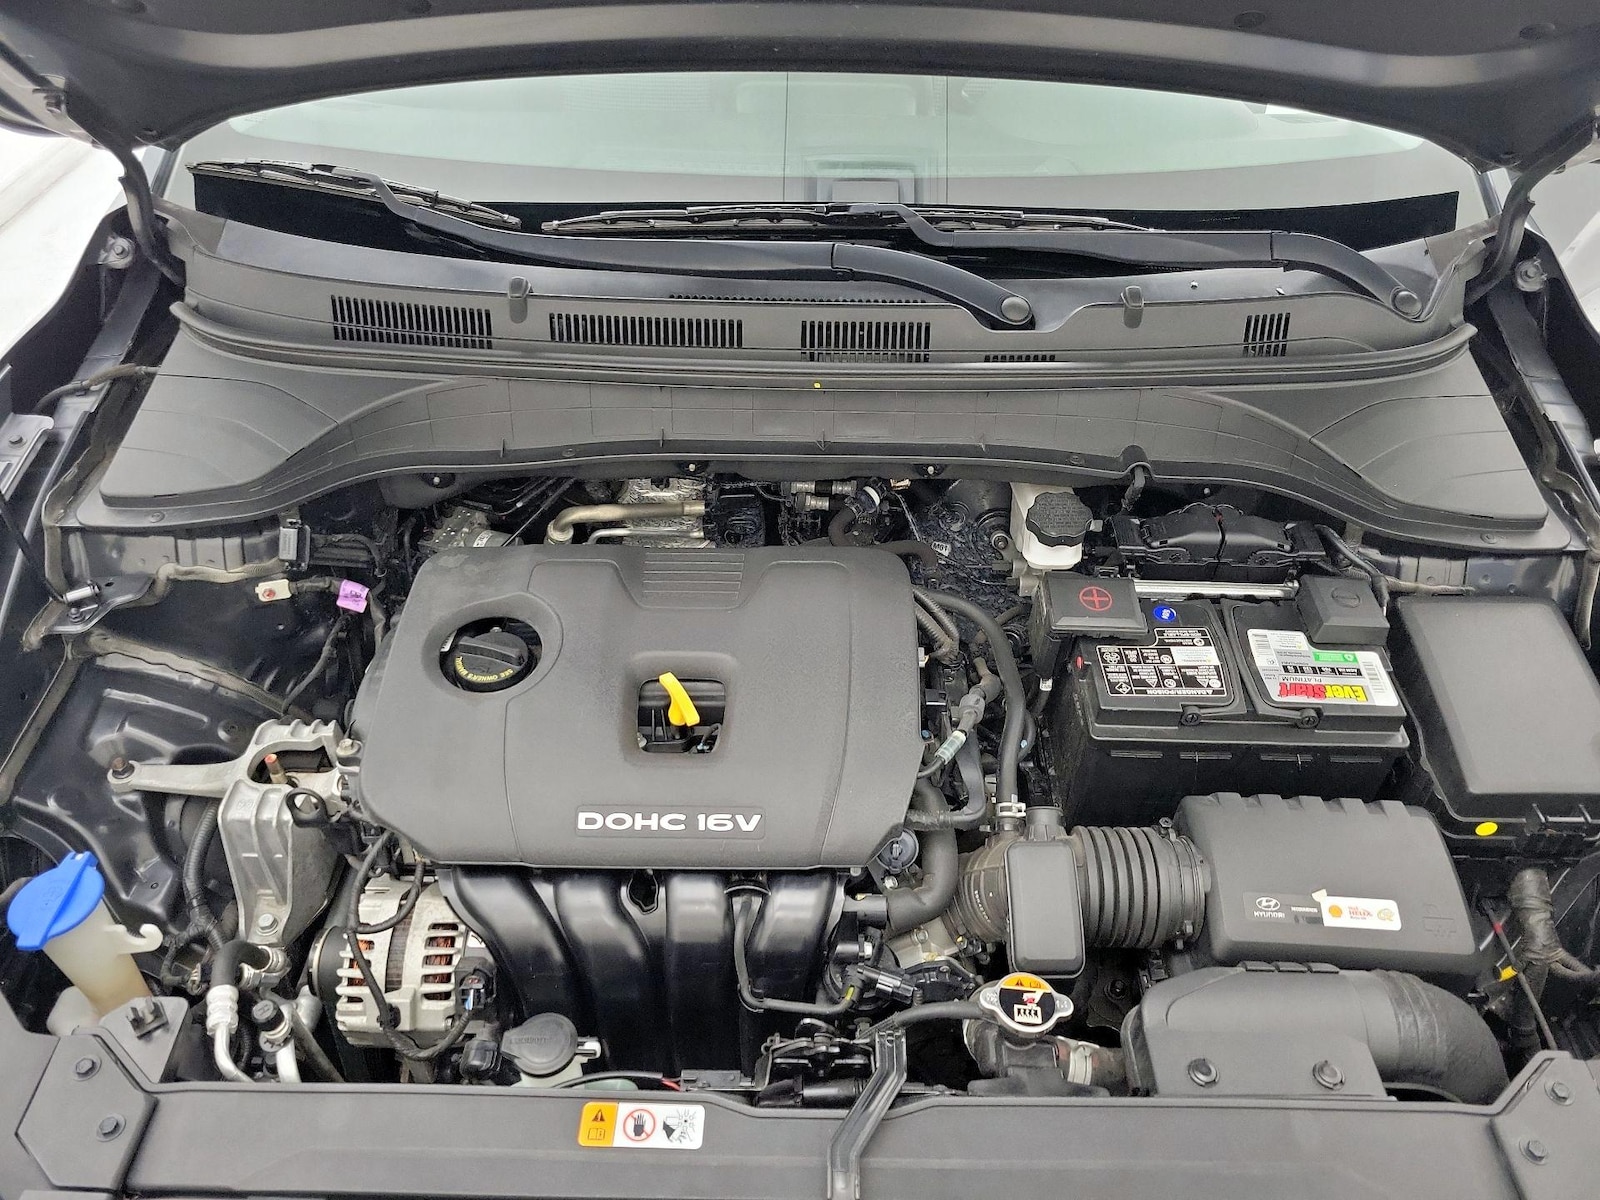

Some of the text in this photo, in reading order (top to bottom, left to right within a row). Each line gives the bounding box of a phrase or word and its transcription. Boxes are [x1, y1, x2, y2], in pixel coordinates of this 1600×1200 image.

[467, 673, 498, 681] OWNER'S
[499, 668, 514, 678] SEE
[1278, 682, 1369, 703] EverStart
[577, 811, 762, 832] DOHC 16V
[1253, 910, 1286, 919] HYUNDAI
